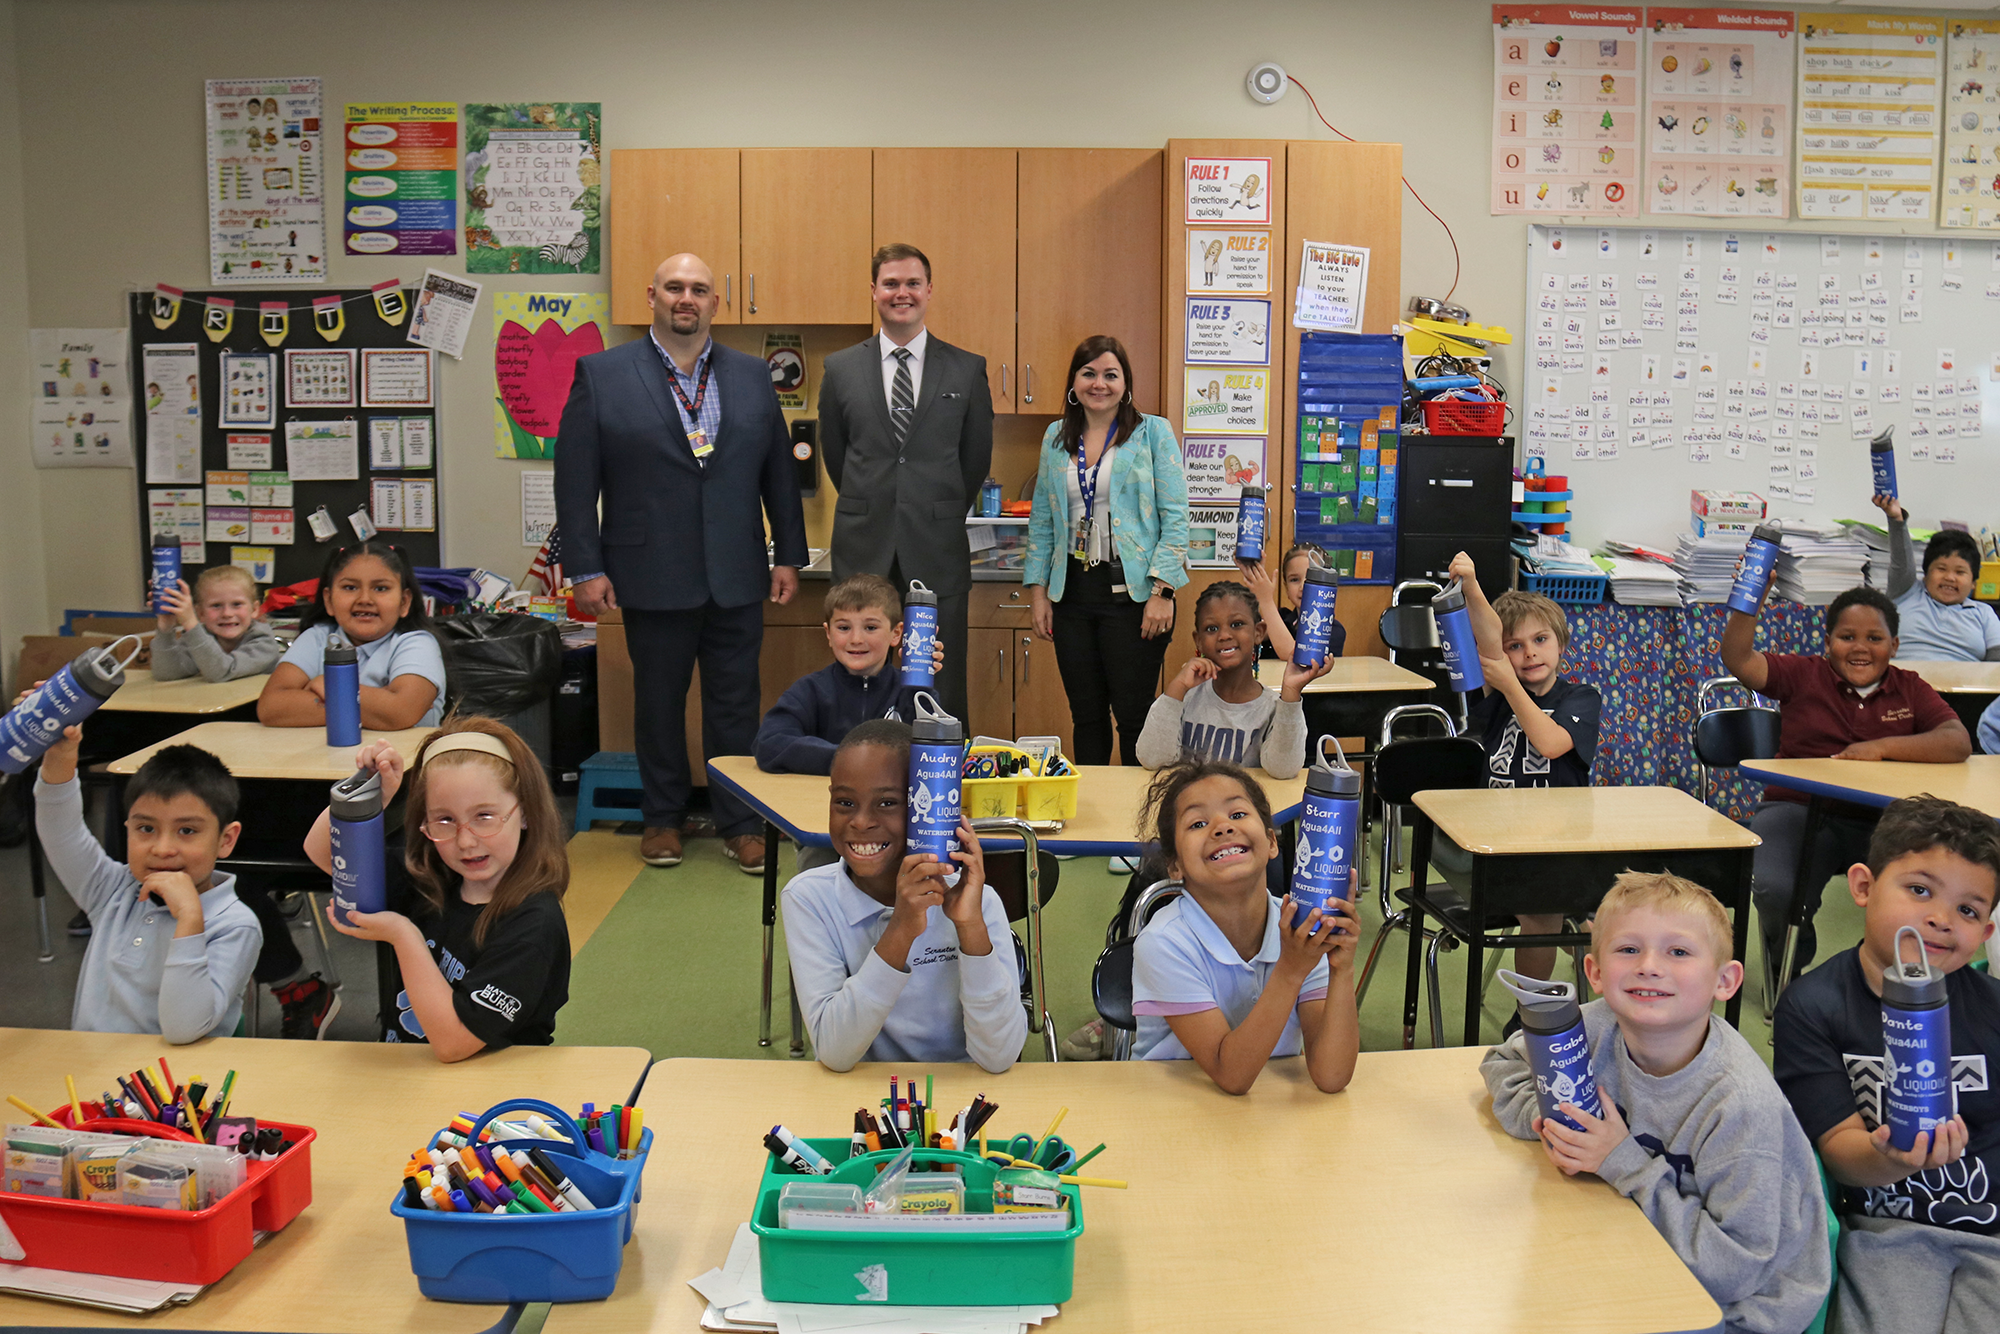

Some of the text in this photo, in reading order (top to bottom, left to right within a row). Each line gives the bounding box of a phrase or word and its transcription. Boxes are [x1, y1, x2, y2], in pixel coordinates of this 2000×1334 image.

[1569, 11, 1636, 21] Vowel Sounds
[1717, 15, 1787, 26] Welded Sounds
[1867, 21, 1895, 29] Mark
[1909, 22, 1937, 31] Words
[1509, 45, 1522, 60] a
[1833, 58, 1852, 66] bath
[1509, 81, 1520, 96] e
[348, 106, 455, 117] The Writing Process:
[1510, 114, 1517, 132] i
[1506, 154, 1519, 168] o
[1190, 165, 1229, 180] RULE 1
[1198, 184, 1221, 193] Follow
[1190, 196, 1229, 204] directions
[1505, 190, 1519, 205] u
[1196, 208, 1223, 218] quickly
[1227, 236, 1267, 251] RULE 2
[1309, 250, 1324, 264] The
[1326, 251, 1339, 265] BIG
[1318, 264, 1349, 274] ALWAYS
[1227, 272, 1256, 280] permission
[1321, 275, 1344, 283] LISTEN
[1602, 280, 1612, 288] by
[528, 295, 572, 317] May
[1777, 300, 1793, 308] find
[1190, 305, 1231, 320] RULE 3
[1331, 305, 1348, 314] they
[1319, 314, 1352, 324] TALKING!
[1643, 319, 1664, 327] carry
[1778, 315, 1790, 324] full
[1823, 315, 1844, 325] going
[1870, 314, 1885, 323] help
[1212, 324, 1225, 332] your
[1568, 322, 1580, 333] all
[1192, 340, 1221, 348] permission
[1677, 341, 1696, 349] drink
[1824, 336, 1840, 345] give
[498, 344, 533, 356] butterfly
[497, 357, 528, 369] ladybug
[1538, 360, 1559, 369] again
[498, 370, 526, 381] garden
[1223, 375, 1263, 389] RULE 4
[502, 384, 521, 393] grow
[505, 393, 530, 405] firefly
[1233, 393, 1252, 402] Make
[1630, 396, 1648, 405] part
[1653, 396, 1670, 405] play
[511, 405, 535, 414] flower
[1187, 403, 1228, 417] APPROVED
[1231, 405, 1253, 413] smart
[1802, 411, 1818, 419] two
[520, 419, 549, 429] tadpole
[1227, 416, 1256, 425] choices
[1601, 430, 1615, 438] out
[1187, 444, 1226, 458] RULE 5
[1691, 453, 1709, 462] right
[1189, 463, 1206, 471] Make
[1186, 474, 1224, 482] dear team
[1188, 486, 1222, 496] stronger
[1189, 511, 1234, 524] DIAMOND
[1217, 530, 1236, 541] Keep
[1318, 590, 1335, 599] Kylie
[920, 752, 957, 766] Audry
[916, 769, 956, 780] Agua4All
[1306, 804, 1340, 819] Starr
[1301, 819, 1341, 835] Agua4All
[1295, 882, 1332, 894] WATERBOYS
[925, 946, 956, 955] Scranton
[913, 956, 937, 966] School
[480, 990, 517, 1018] BURNE
[1881, 1011, 1923, 1030] Dante
[1549, 1034, 1584, 1053] Gabe
[1887, 1097, 1929, 1113] WATERBOYS
[901, 1199, 947, 1209] Crayola
